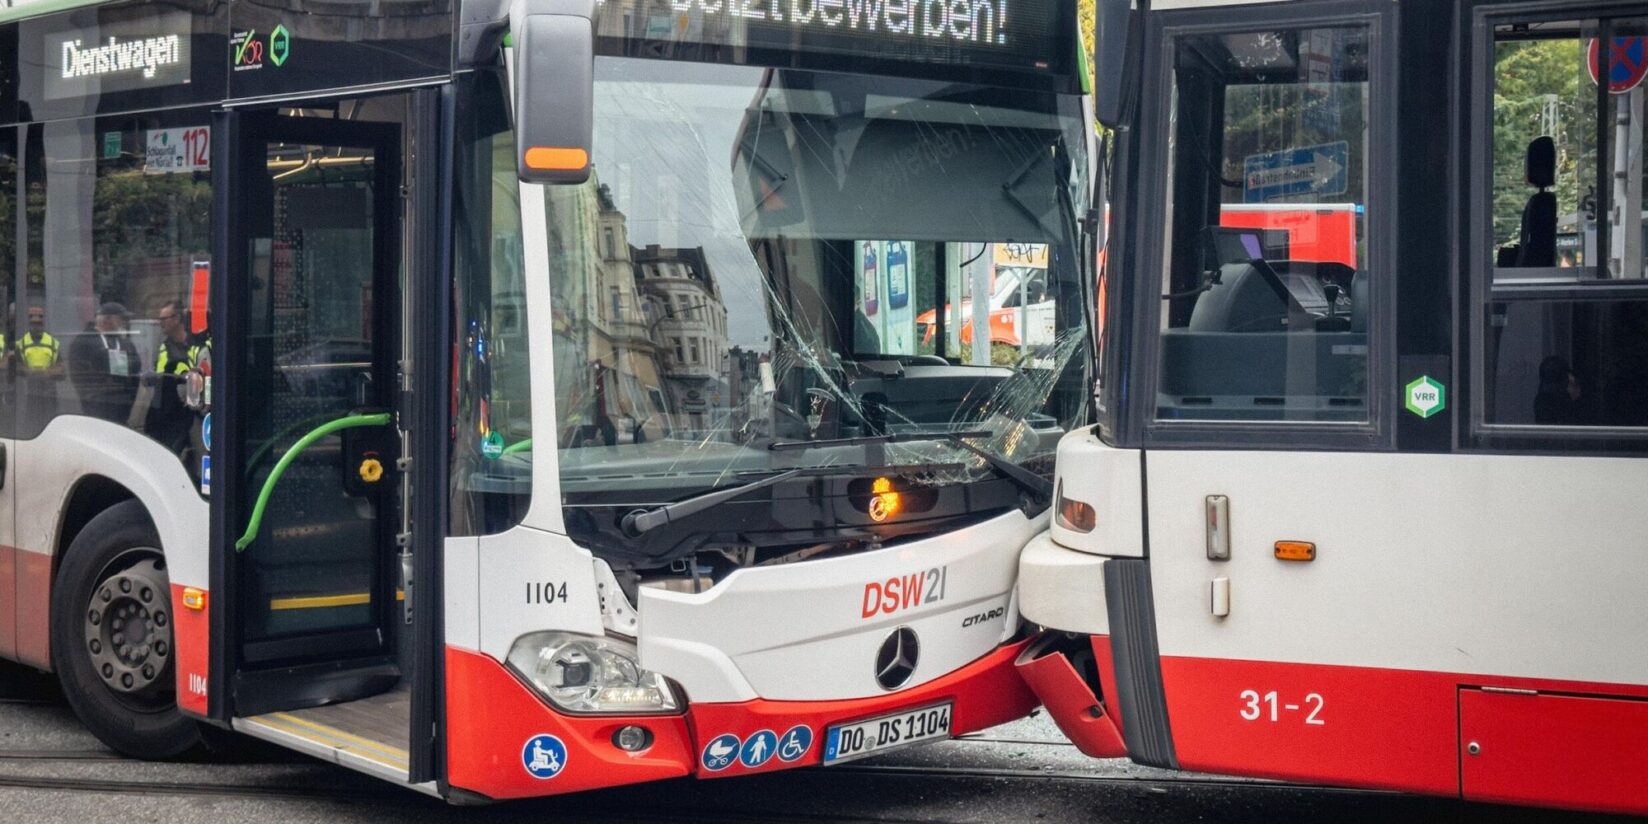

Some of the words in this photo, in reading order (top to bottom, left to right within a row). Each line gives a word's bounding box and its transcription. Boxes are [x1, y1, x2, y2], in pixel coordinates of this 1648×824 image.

[62, 33, 179, 79] Dienstwagen
[183, 127, 208, 166] 112
[1414, 392, 1436, 401] VRR
[526, 582, 568, 604] 1104
[861, 566, 947, 619] DSW21
[962, 606, 1004, 628] CITARO
[189, 673, 207, 696] 1104
[1239, 689, 1325, 725] 31-2
[839, 727, 864, 754] DO
[877, 717, 901, 746] DS
[904, 708, 948, 740] 1104
